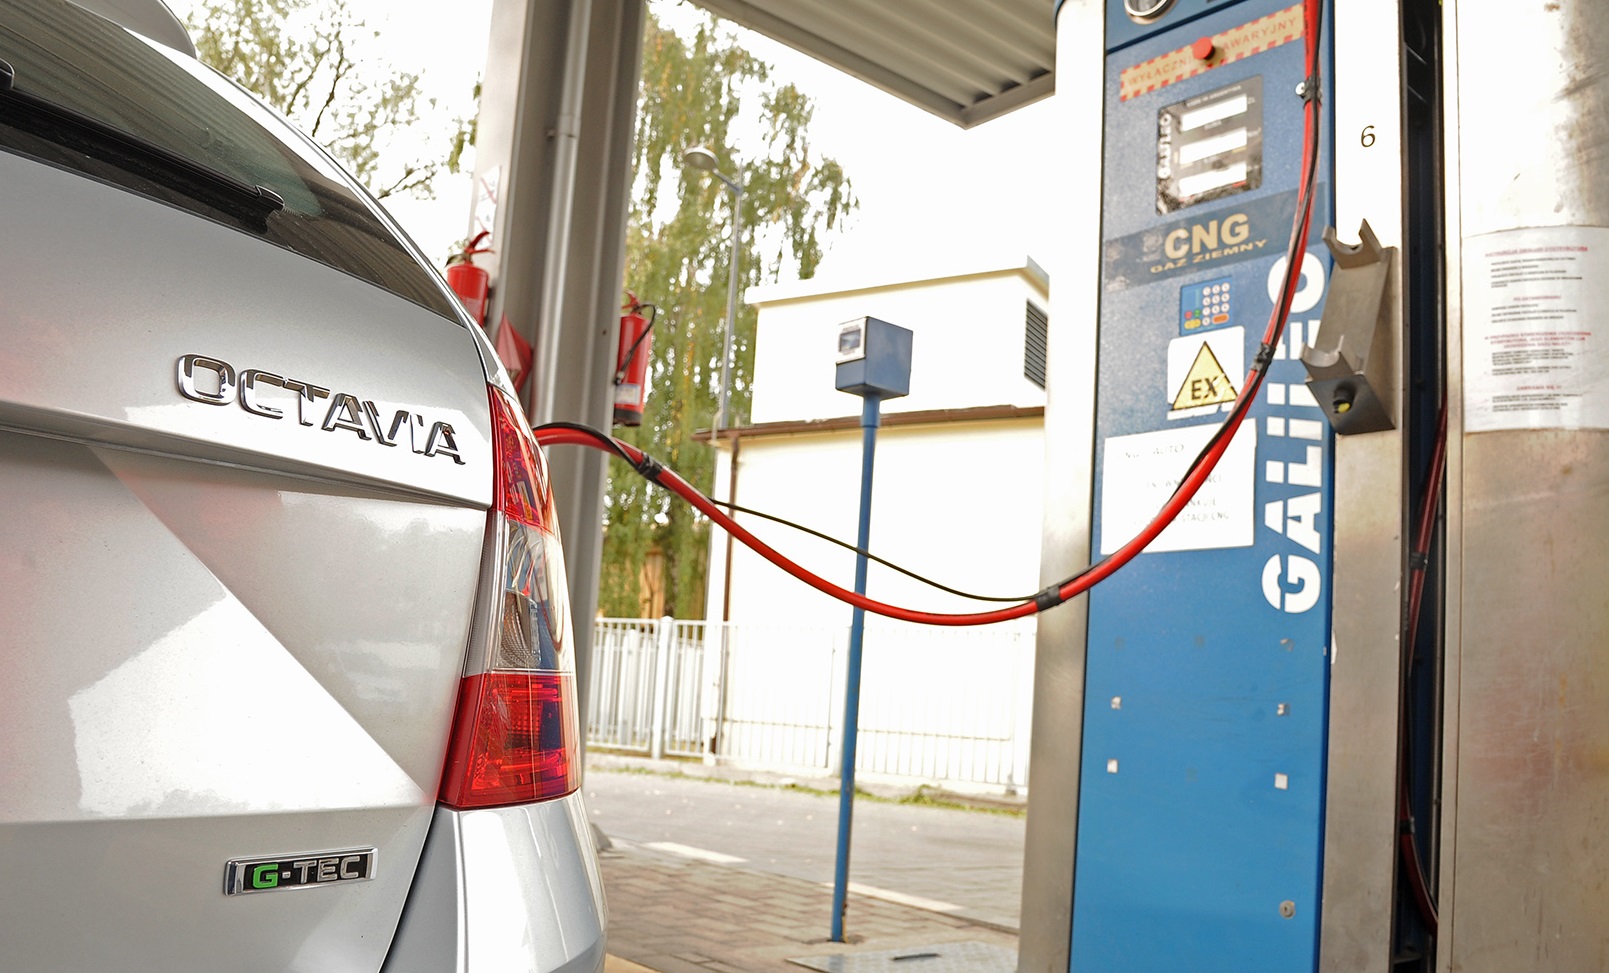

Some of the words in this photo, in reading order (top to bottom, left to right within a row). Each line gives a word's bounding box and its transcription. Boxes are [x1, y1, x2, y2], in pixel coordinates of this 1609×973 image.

[1222, 17, 1298, 51] AWARYJNY
[1360, 125, 1376, 148] 6
[1164, 213, 1249, 260] CNG
[1150, 257, 1188, 273] GAZ
[1192, 239, 1268, 263] ZIEMNY
[1190, 375, 1219, 400] EX
[176, 353, 466, 465] OCTAVIA
[252, 856, 360, 889] G-TEC
